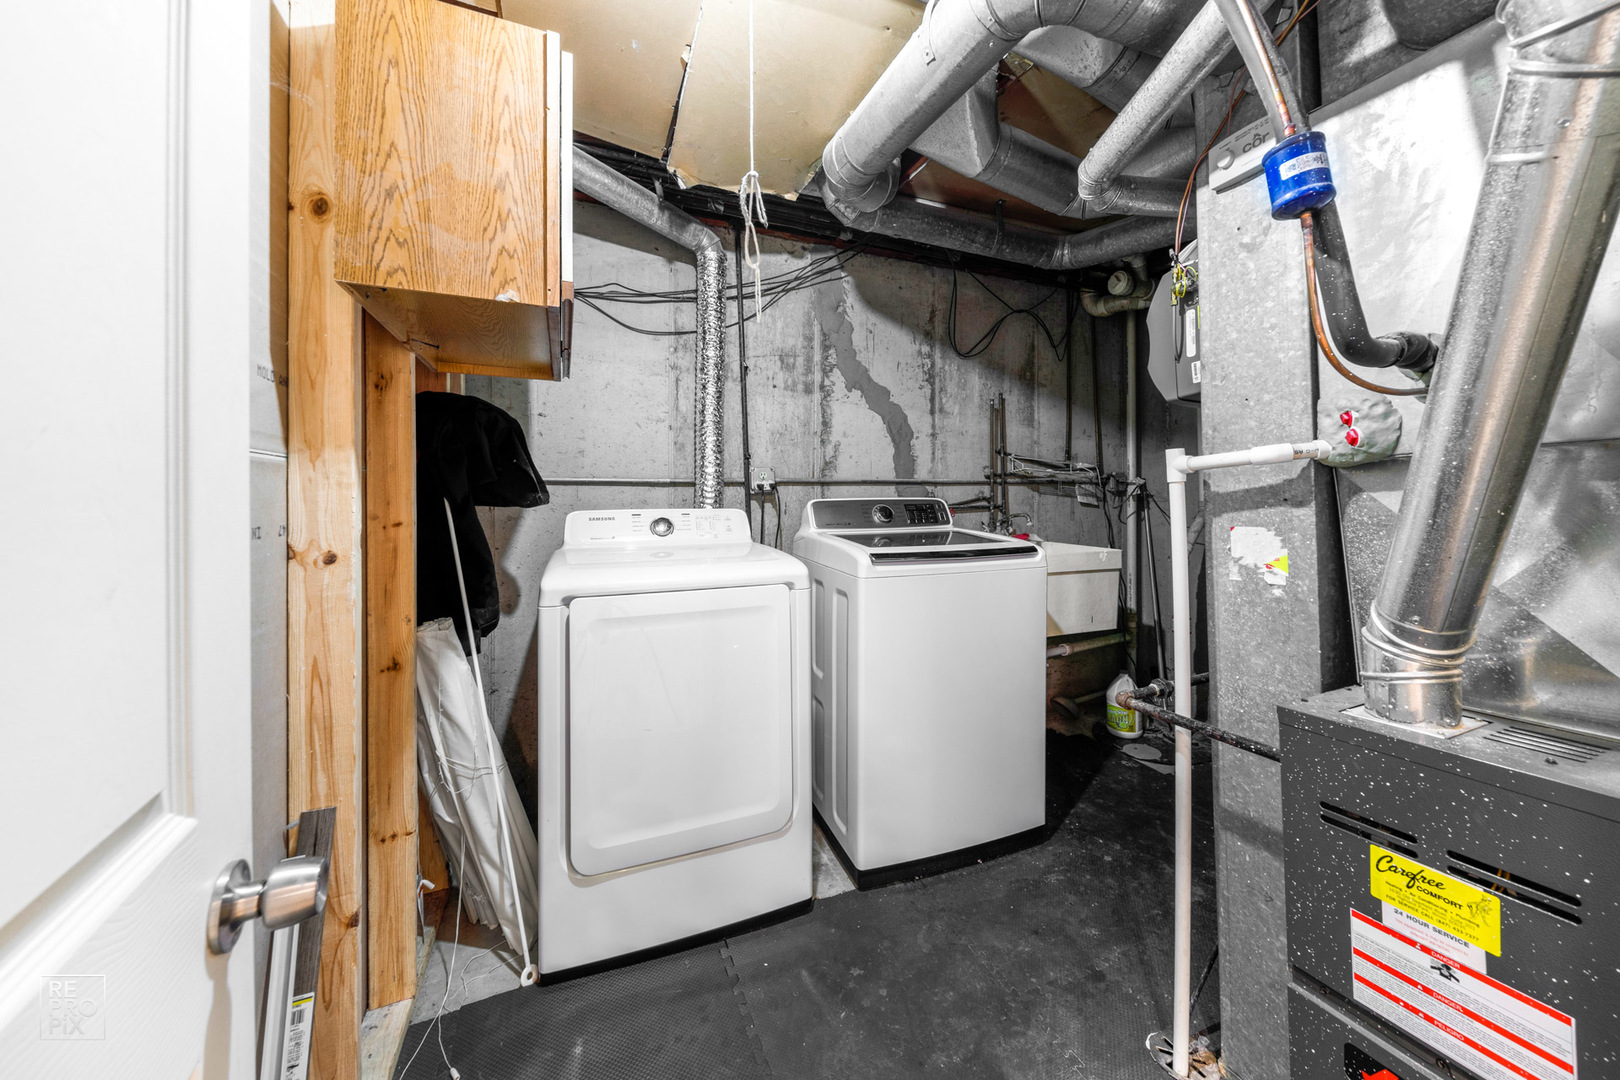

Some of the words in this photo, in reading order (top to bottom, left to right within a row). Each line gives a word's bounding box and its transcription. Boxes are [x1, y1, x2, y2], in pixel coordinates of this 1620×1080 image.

[256, 363, 276, 383] MOLD
[1376, 855, 1446, 890] Carefree
[1386, 893, 1395, 902] FOR
[1398, 899, 1418, 913] SERVICE
[1420, 910, 1433, 920] CALL
[1416, 885, 1463, 910] COMFORT
[1417, 895, 1447, 913] Conditioning
[1456, 912, 1479, 928] Plumbing
[1394, 907, 1404, 917] 24
[1406, 914, 1430, 930] HOUR
[1432, 926, 1470, 948] SERVICE
[1431, 951, 1460, 970] DANGER
[1433, 992, 1462, 1011] DANGER
[1434, 1020, 1464, 1040] PELIGRO
